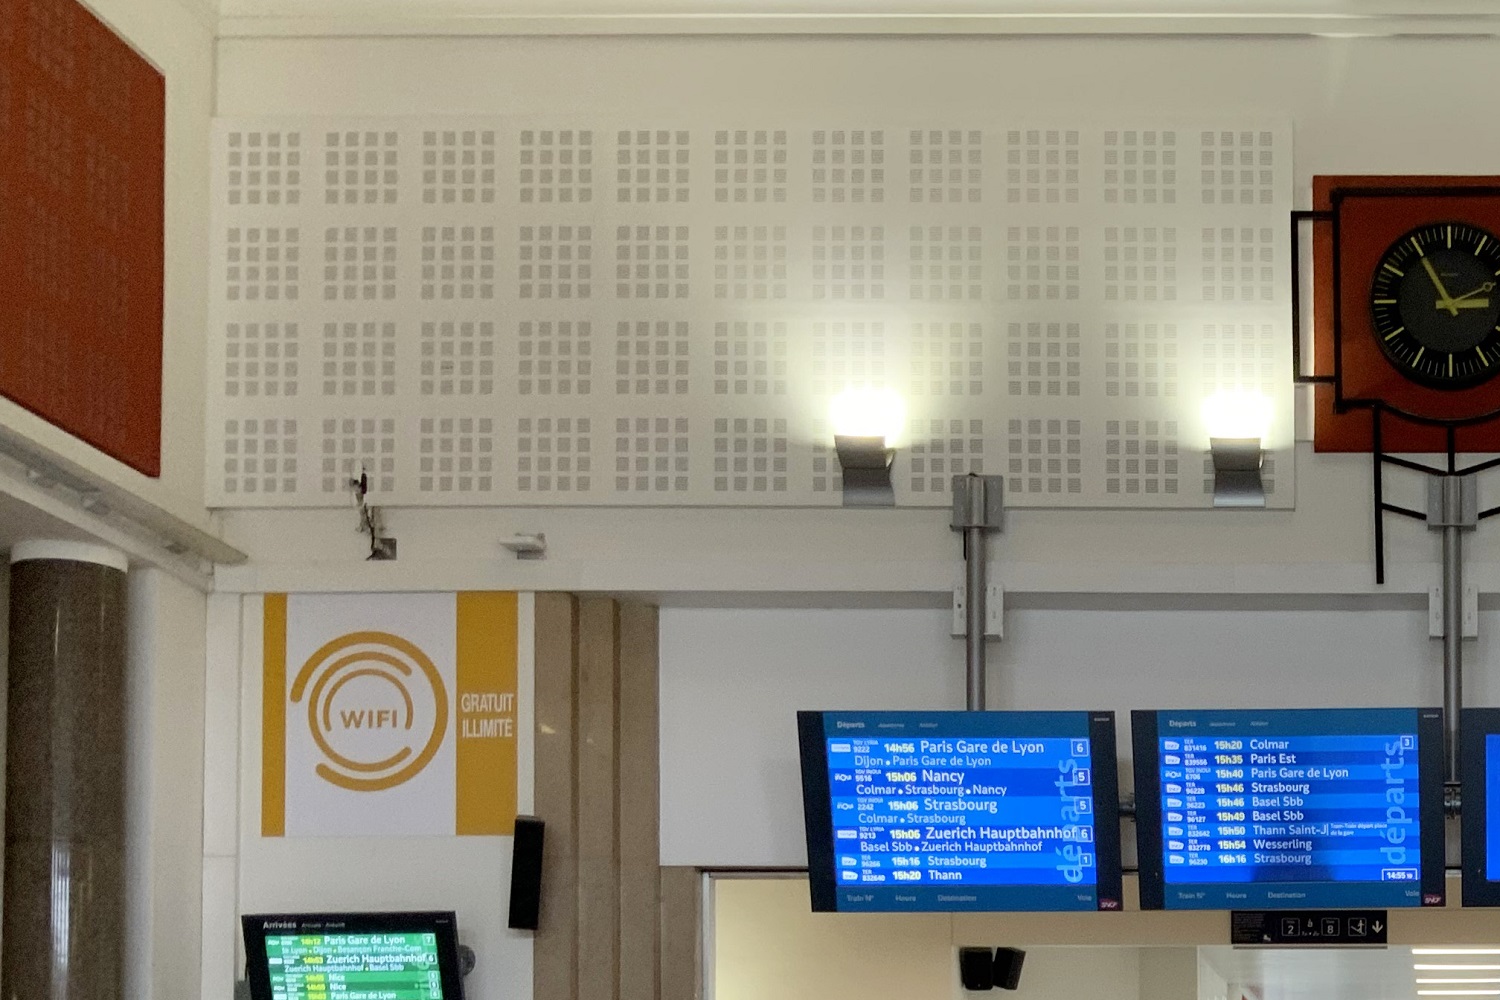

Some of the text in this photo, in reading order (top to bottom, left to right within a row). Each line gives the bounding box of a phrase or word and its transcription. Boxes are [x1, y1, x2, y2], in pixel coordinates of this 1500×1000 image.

[461, 693, 514, 713] GRATUIT
[340, 710, 398, 729] WIFI
[462, 716, 513, 738] ILLIMITÉ
[884, 740, 1044, 756] 14h56 Paris Gare de Lyon
[1250, 739, 1289, 749] Colmar
[855, 756, 991, 768] Dijon Paris Gare de Lyon
[1250, 753, 1296, 764] Paris Est
[922, 770, 964, 785] Nancy
[1215, 767, 1349, 780] 15h40 Paris Gare de Lyon
[857, 784, 1007, 797] Colmar Strasbourg Nancy
[1251, 782, 1310, 795] Strasbourg
[924, 798, 998, 814] Strasbourg
[1252, 797, 1303, 807] Basel Sbb
[1380, 742, 1412, 864] départs
[859, 813, 966, 826] Colmar Strasbourg
[926, 826, 1077, 842] Zuerich Hauptbahnhof
[1252, 825, 1286, 835] Thann
[861, 841, 1043, 853] Basel Sbb Zuerich Hauptbahnhof
[1253, 839, 1312, 852] Wesserling
[928, 856, 987, 868] Strasbourg
[1254, 853, 1311, 866] Strasbourg
[928, 870, 962, 880] Thann
[324, 936, 405, 947] Paris Gare de Lyon
[326, 954, 426, 965] Zuerich Hauptbahnhof
